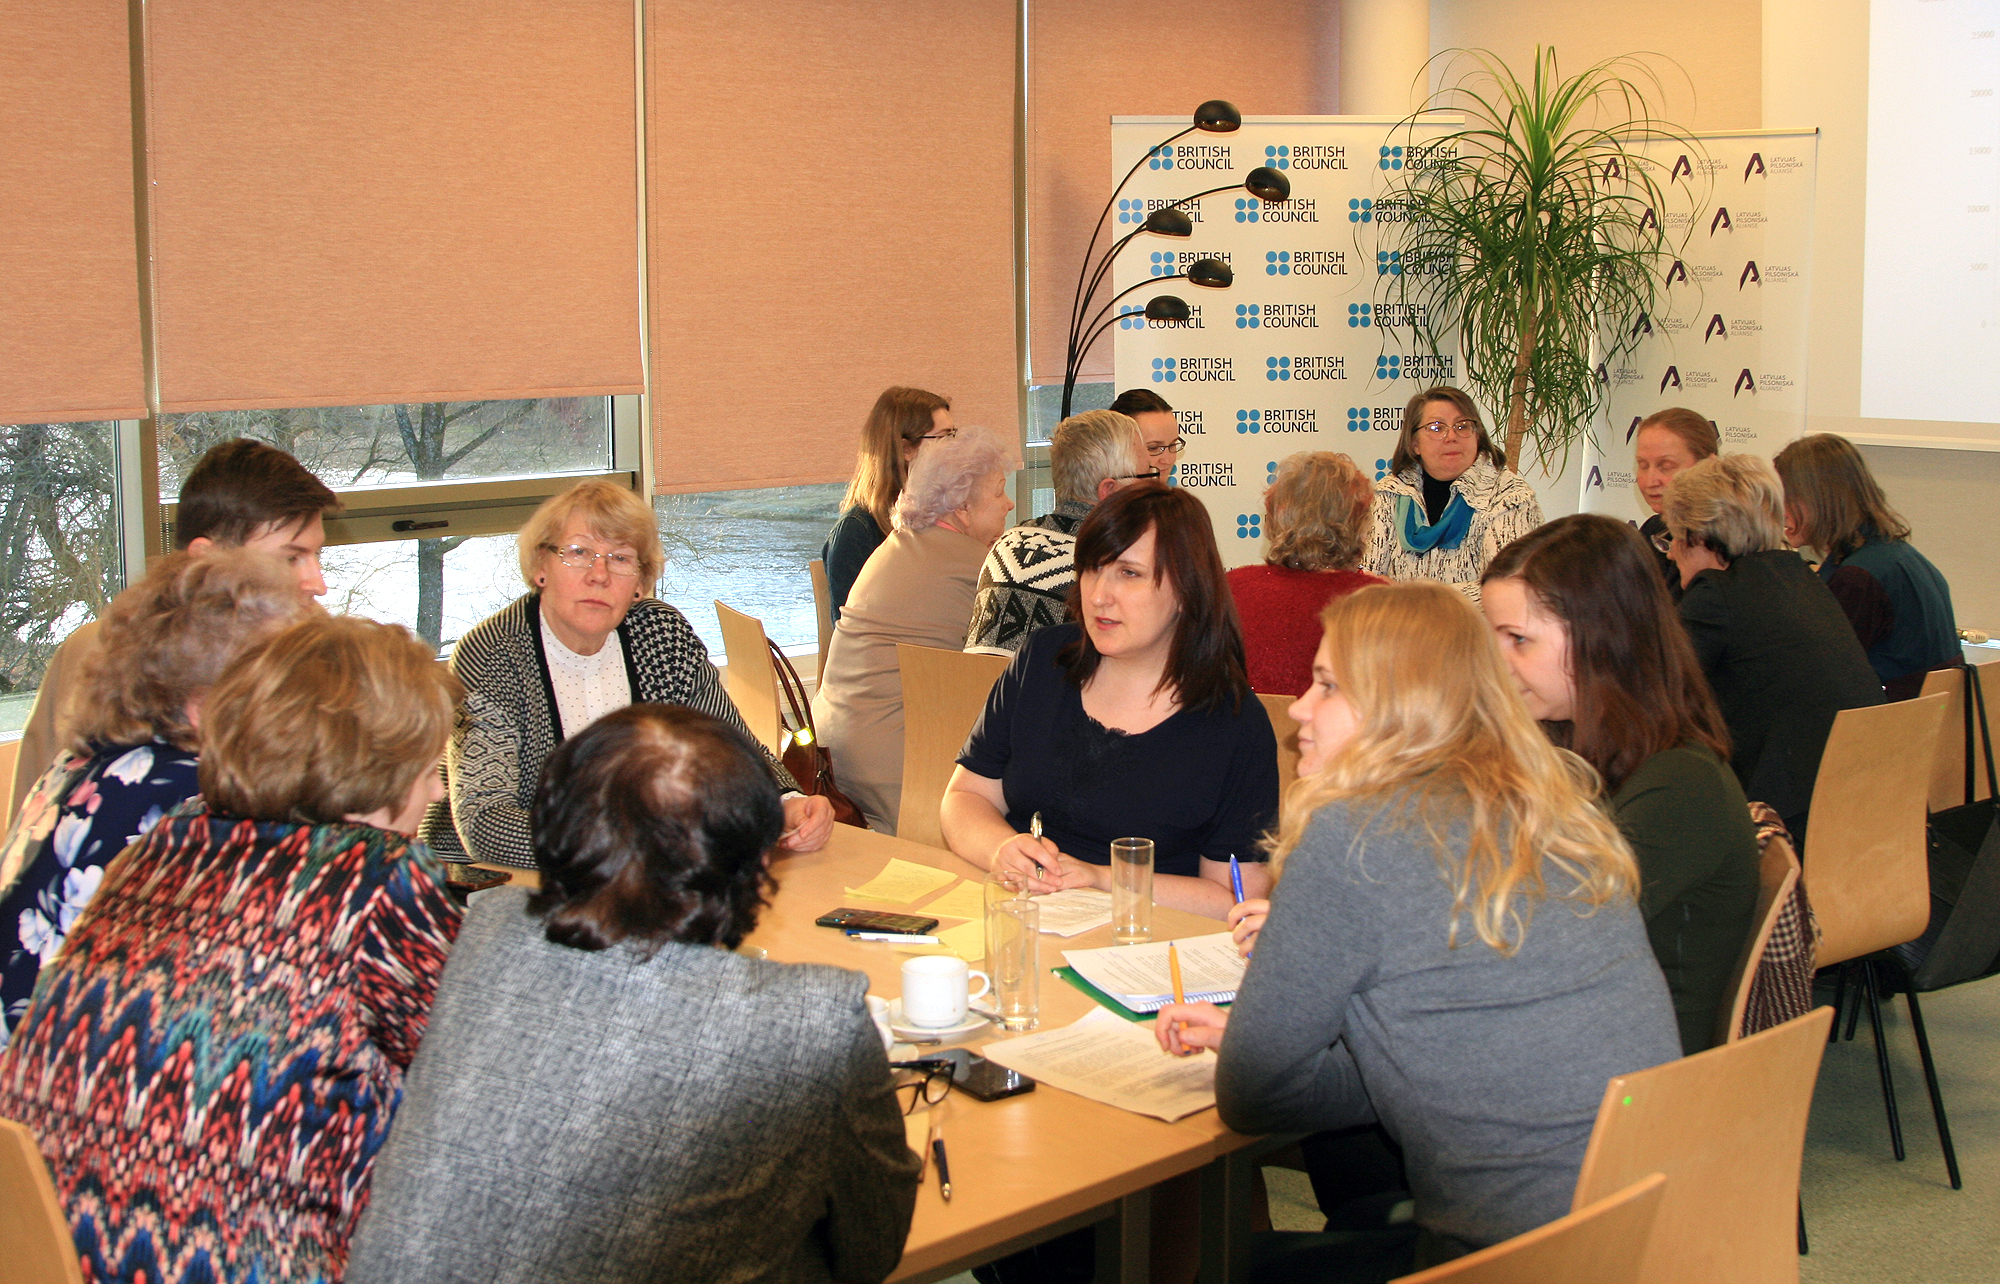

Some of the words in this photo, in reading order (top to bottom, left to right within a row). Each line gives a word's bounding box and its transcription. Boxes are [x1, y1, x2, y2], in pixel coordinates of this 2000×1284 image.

[1178, 146, 1231, 157] BRITISH
[1293, 146, 1345, 157] BRITISH
[1407, 147, 1457, 157] BRITISH
[1177, 158, 1234, 170] COUNCIL
[1293, 158, 1348, 170] COUNCIL
[1263, 199, 1315, 210] BRITISH
[1262, 212, 1319, 223] COUNCIL
[1375, 211, 1431, 223] COUNCIL
[1294, 252, 1345, 263] BRITISH
[1294, 264, 1348, 275] COUNCIL
[1405, 264, 1452, 275] COUNCI
[1263, 304, 1316, 316] BRITISH
[1375, 304, 1426, 315] BRITISH
[1148, 317, 1205, 329] COUNCIL
[1263, 317, 1319, 328] COUNCIL
[1374, 316, 1428, 327] COUNCIL
[1180, 358, 1232, 369] BRITISH
[1294, 357, 1344, 368] BRITISH
[1404, 356, 1453, 367] BRITISH
[1180, 370, 1235, 381] COUNCIL
[1294, 369, 1347, 380] COUNCIL
[1403, 368, 1455, 379] COUNCIL
[1172, 411, 1202, 422] TISH
[1264, 409, 1316, 421] BRITISH
[1373, 408, 1406, 418] BRITI
[1178, 423, 1206, 435] NCIL
[1263, 422, 1319, 433] COUNCIL
[1181, 463, 1233, 475] BRITISH
[1180, 476, 1237, 487] COUNCIL
